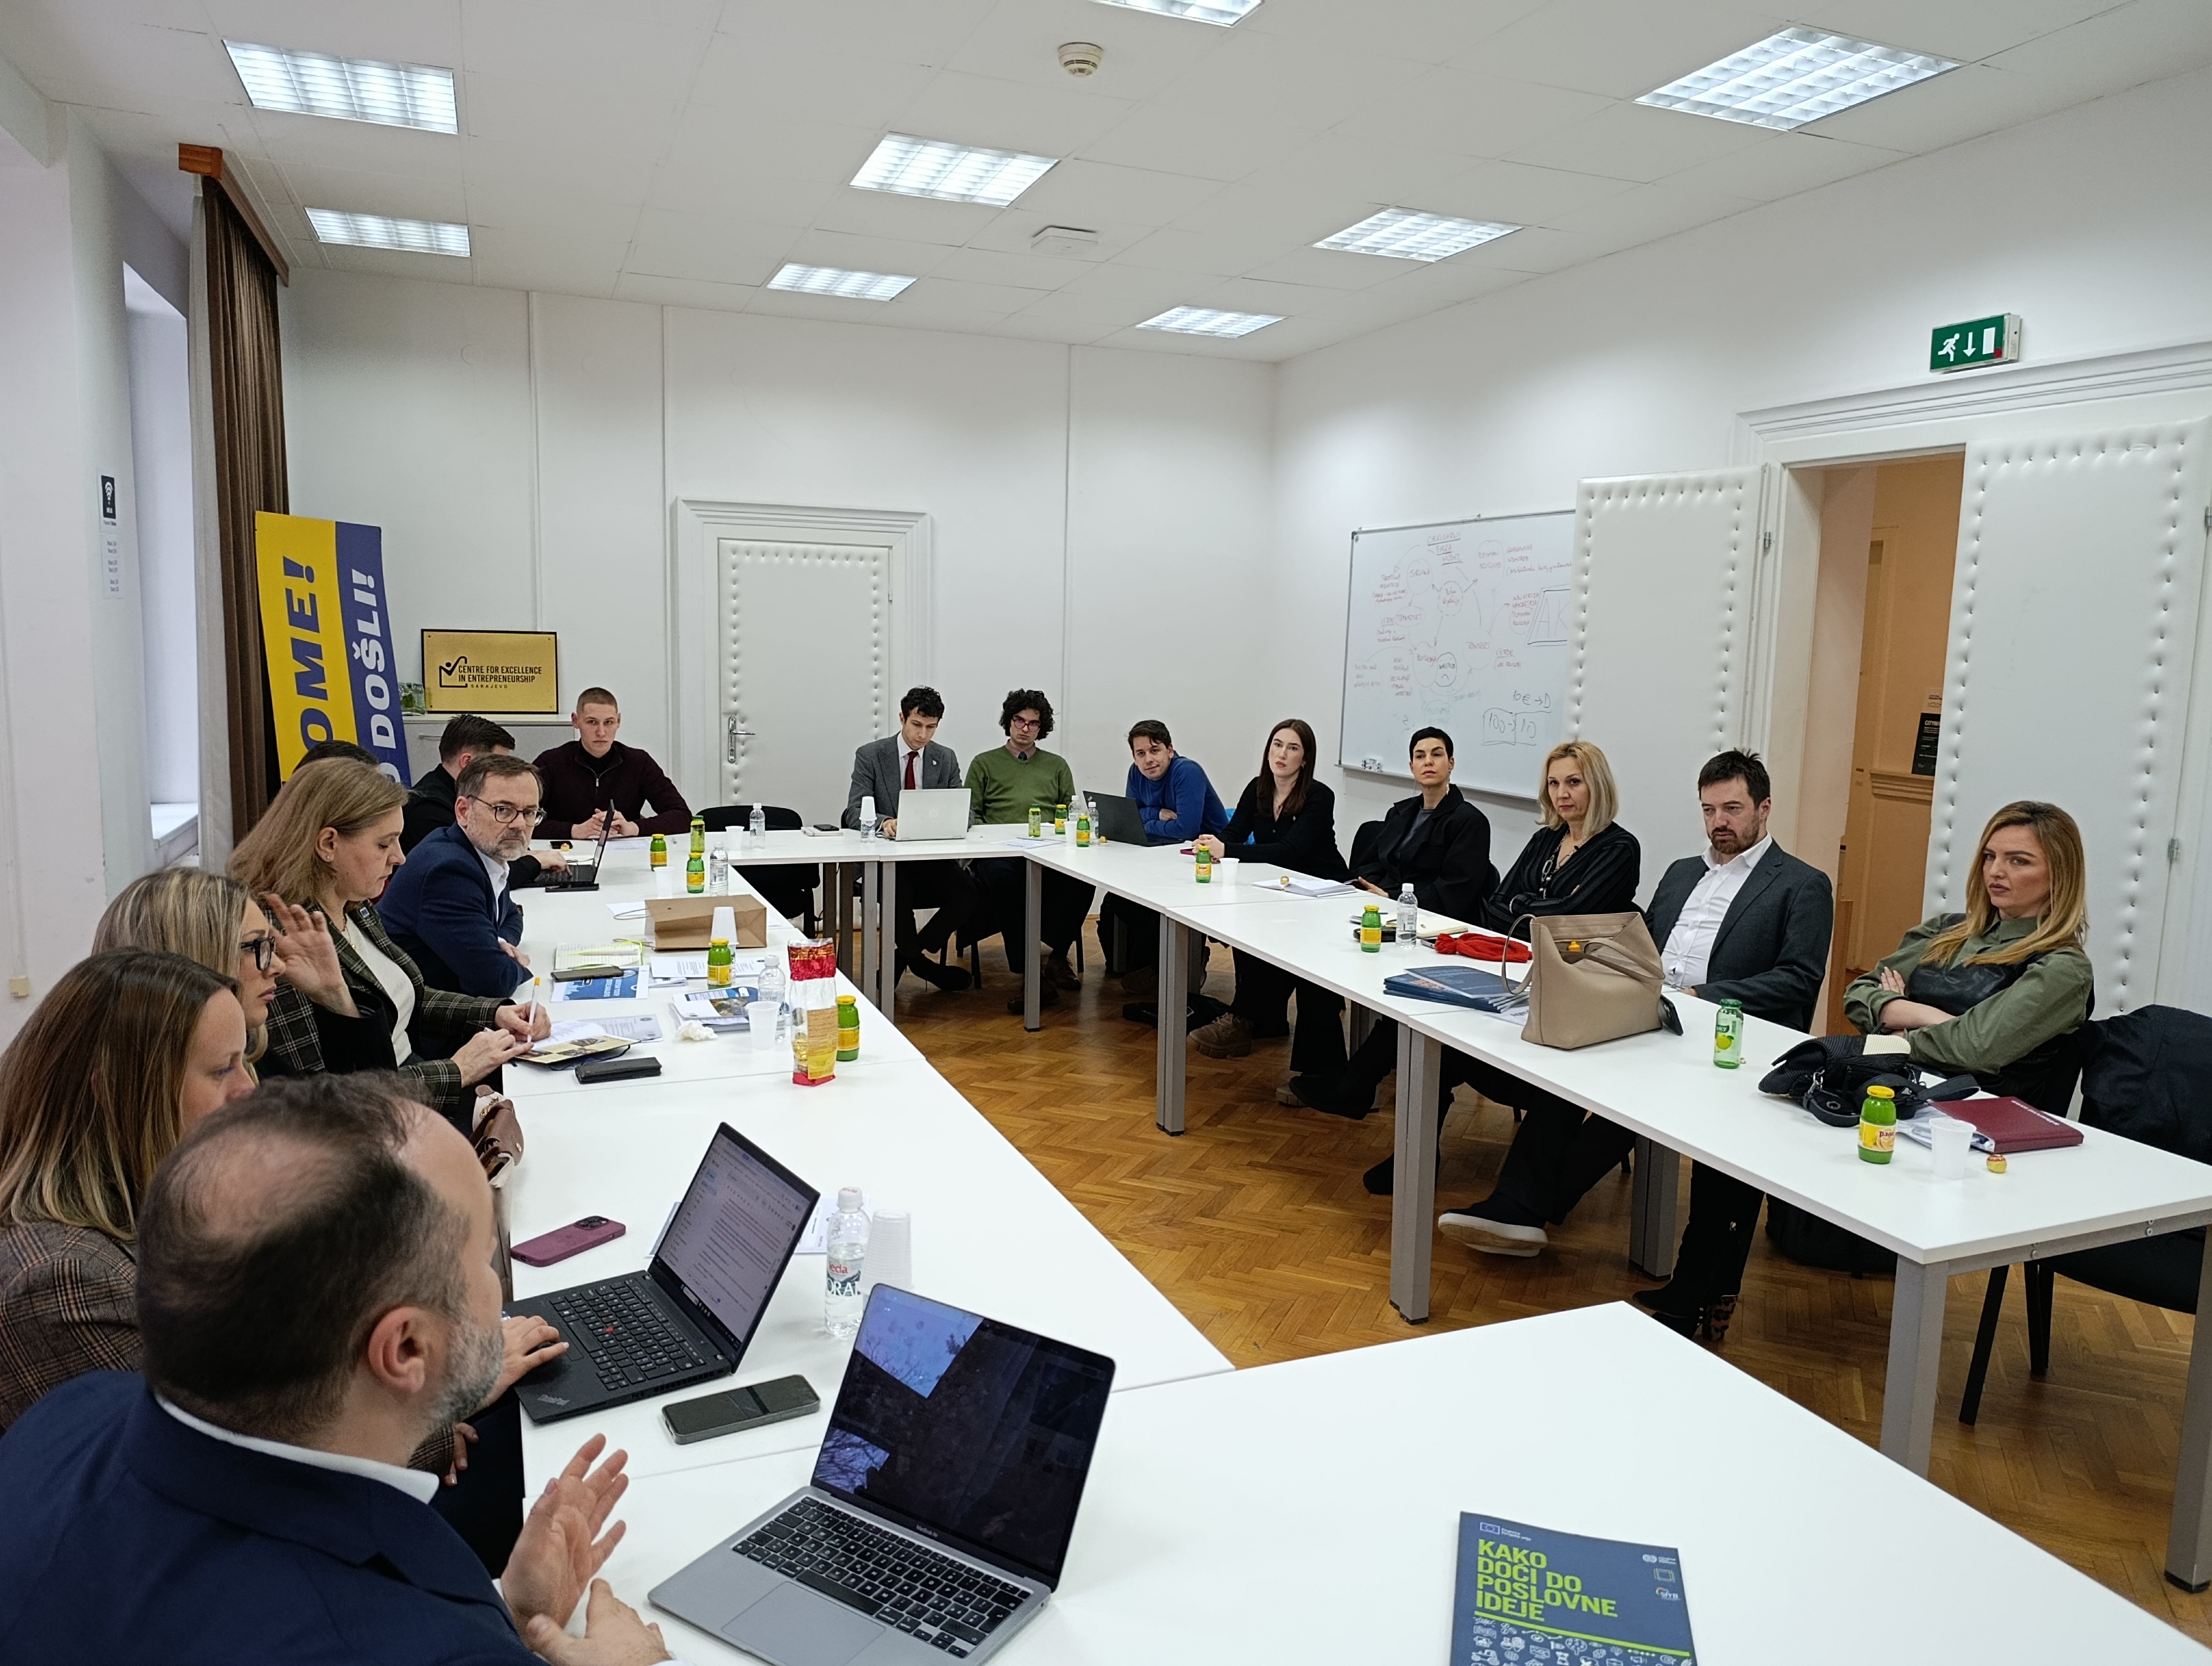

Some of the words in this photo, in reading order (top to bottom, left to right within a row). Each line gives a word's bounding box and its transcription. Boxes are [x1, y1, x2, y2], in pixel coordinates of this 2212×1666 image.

[352, 569, 396, 749] DOŠLI!
[459, 665, 484, 674] CENTRE
[501, 666, 542, 674] EXCELLENCE
[468, 675, 536, 683] ENTREPRENEURSHIP
[1478, 1539, 1547, 1568] KAKO
[1477, 1573, 1618, 1617] POSLOVNE
[1546, 1571, 1582, 1592] DO
[1476, 1590, 1545, 1622] IDEJE
